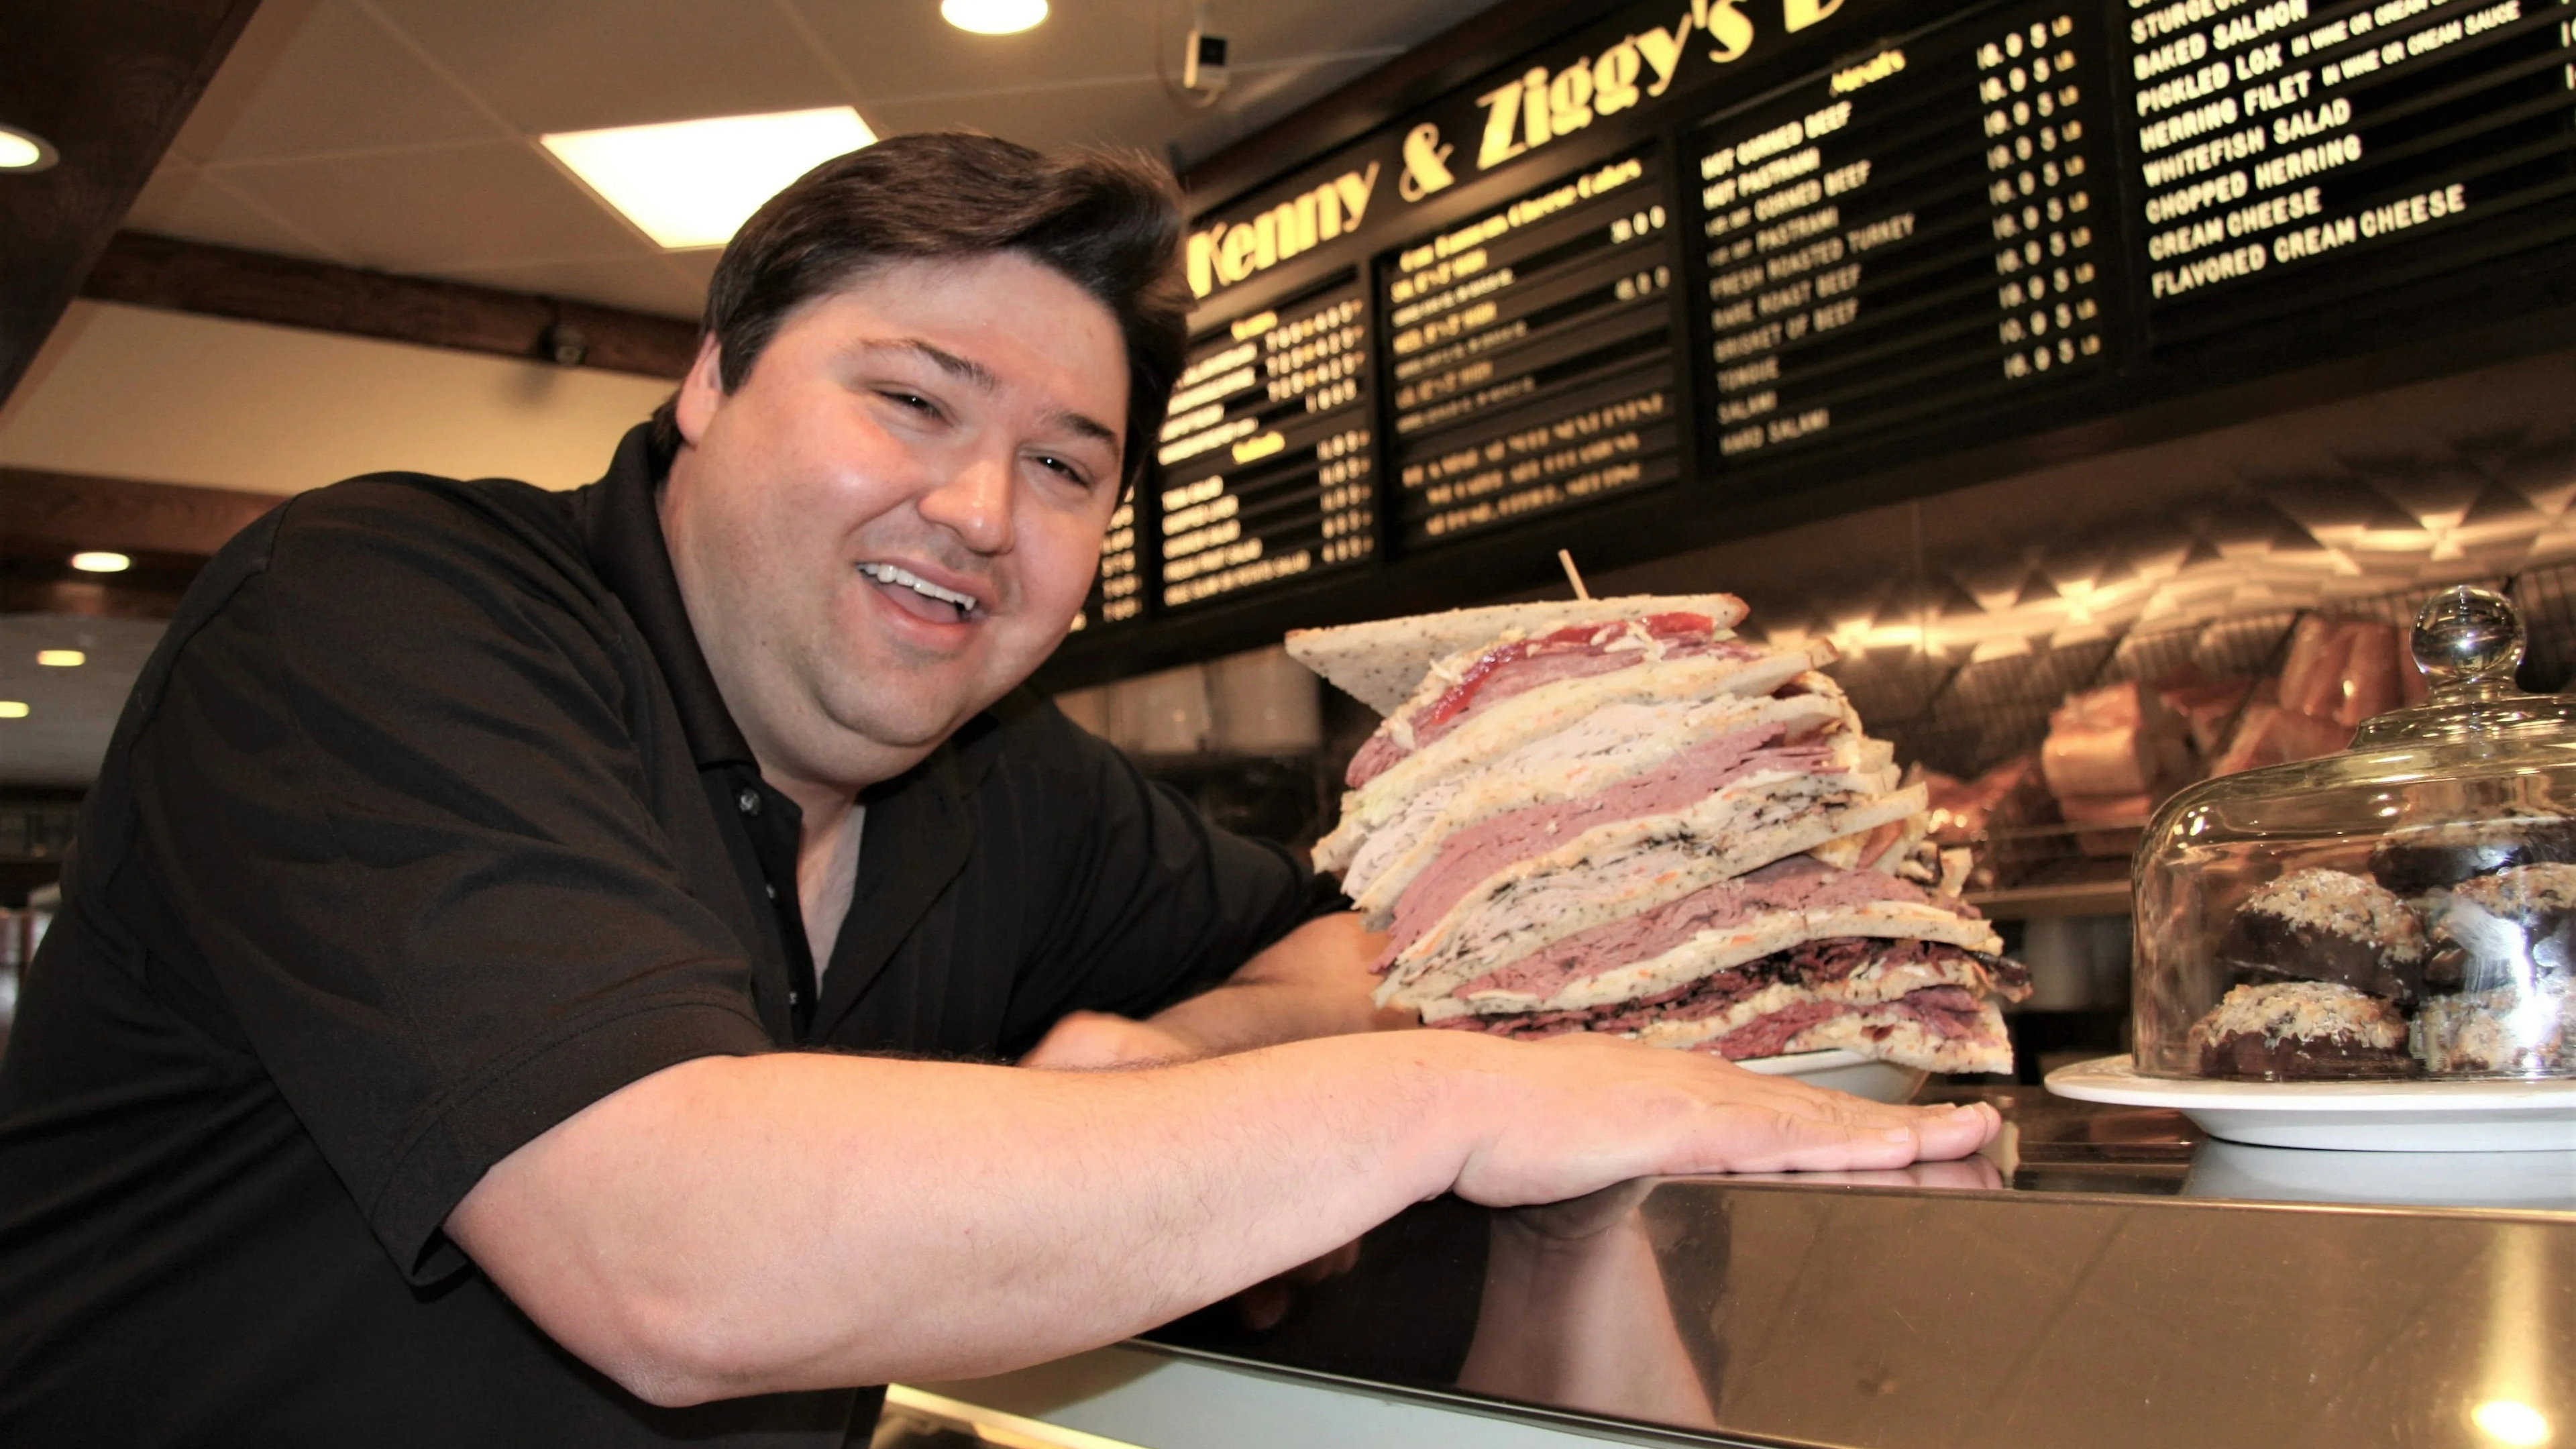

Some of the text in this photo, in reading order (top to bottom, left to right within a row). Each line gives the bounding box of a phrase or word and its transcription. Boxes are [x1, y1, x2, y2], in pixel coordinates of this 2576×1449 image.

[2133, 0, 2309, 80] BAKED SALMON
[2139, 97, 2239, 154] HERRING
[2243, 69, 2312, 117] FILET
[2406, 19, 2463, 56] CREAM
[2464, 0, 2522, 36] SAUCE
[2136, 61, 2231, 117] PICKLED
[2235, 42, 2284, 81] LOX
[1186, 160, 1380, 299] Kenny
[1398, 122, 1455, 203] &
[1476, 0, 1755, 170] Ziggy's
[1805, 100, 1852, 139] BEEF
[2141, 97, 2352, 188] WHITEFISH SALAD
[1823, 159, 1872, 197] BEEF
[2145, 133, 2363, 224] CHOPPED HERRING
[1847, 212, 1915, 254] TURKEY
[2147, 186, 2323, 261] CREAM CHEESE
[2151, 183, 2467, 299] FLAVORED CREAM CHEESE
[1813, 297, 1860, 331] BEEF
[1816, 263, 1862, 299] BEEF
